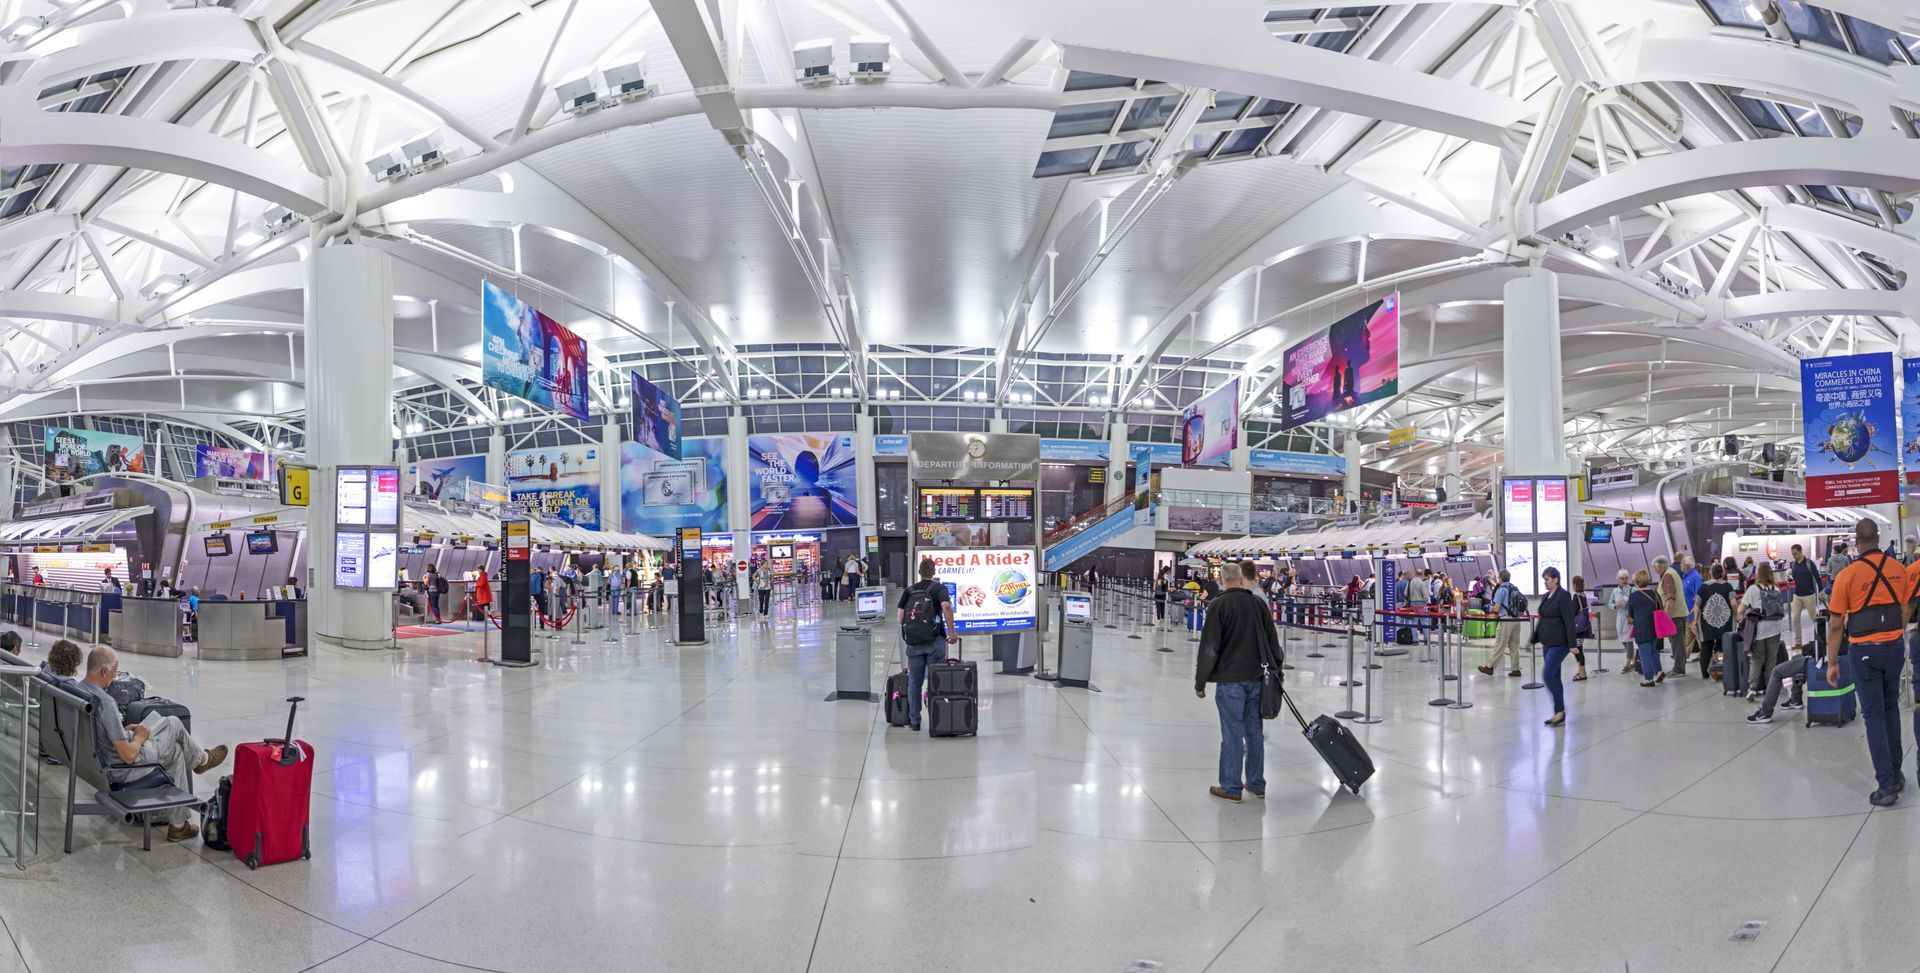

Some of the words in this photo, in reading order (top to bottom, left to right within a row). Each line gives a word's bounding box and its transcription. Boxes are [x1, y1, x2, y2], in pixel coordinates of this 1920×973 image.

[1814, 370, 1848, 380] MIRACLES
[1858, 368, 1882, 376] CHINA
[1814, 378, 1854, 388] COMMERCE
[1863, 375, 1882, 383] YIWU
[70, 449, 91, 457] WORLD
[919, 461, 968, 469] DEPARTU
[974, 462, 1033, 470] INFORMATION
[755, 467, 787, 475] WORLD
[761, 474, 795, 483] FASTER
[292, 485, 302, 500] G
[516, 491, 538, 501] TAKE
[546, 490, 576, 499] BREAK
[575, 497, 589, 506] ON
[918, 526, 952, 534] BRAVELY
[1065, 546, 1079, 556] smart
[1099, 527, 1113, 538] smart
[970, 554, 981, 566] A
[985, 553, 1030, 566] Ride?
[938, 567, 966, 575] CARMEL
[997, 581, 1031, 595] CARMEL
